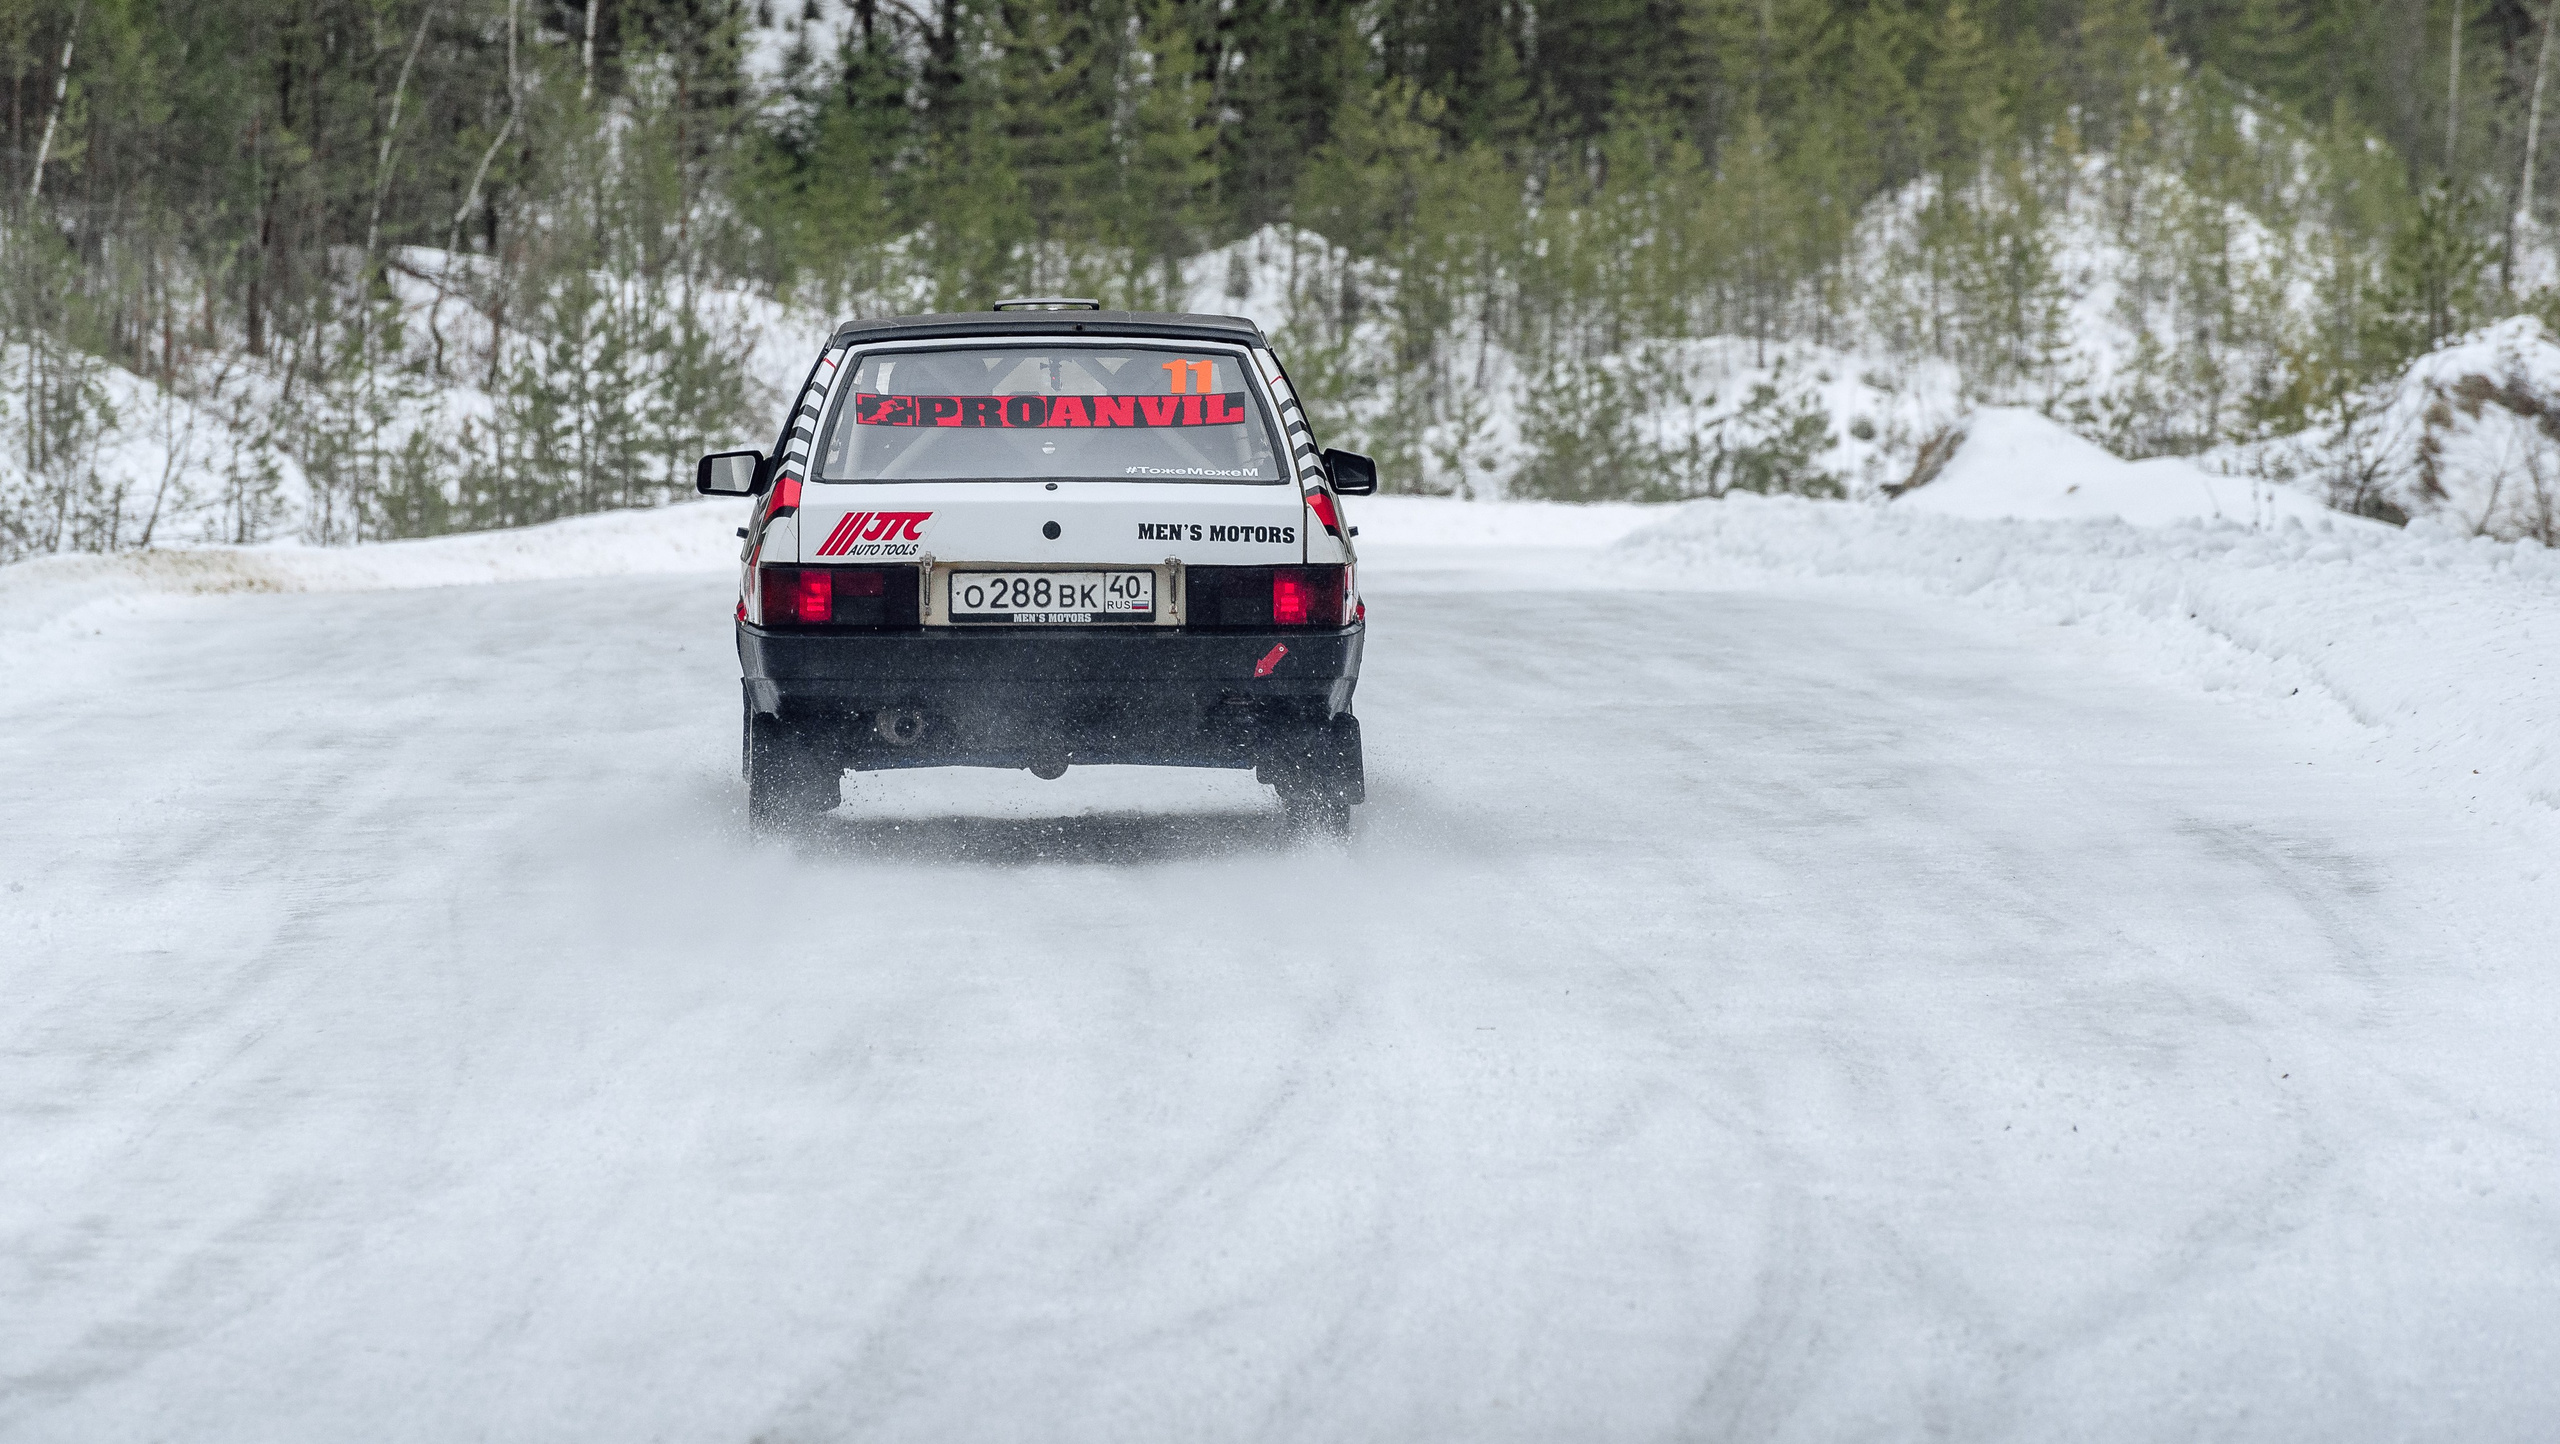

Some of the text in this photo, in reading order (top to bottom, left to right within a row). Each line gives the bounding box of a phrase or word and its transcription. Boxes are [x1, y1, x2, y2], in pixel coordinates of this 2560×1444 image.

[1162, 359, 1213, 394] 11
[918, 394, 1245, 428] PROANVIL
[862, 511, 934, 541] JTC
[1138, 523, 1296, 544] MEN'S MOTORS
[847, 544, 919, 556] AUTO TOOLS
[1109, 575, 1141, 599] 40
[1107, 600, 1131, 610] RUS
[1013, 613, 1092, 623] MEN'S MOTORS
